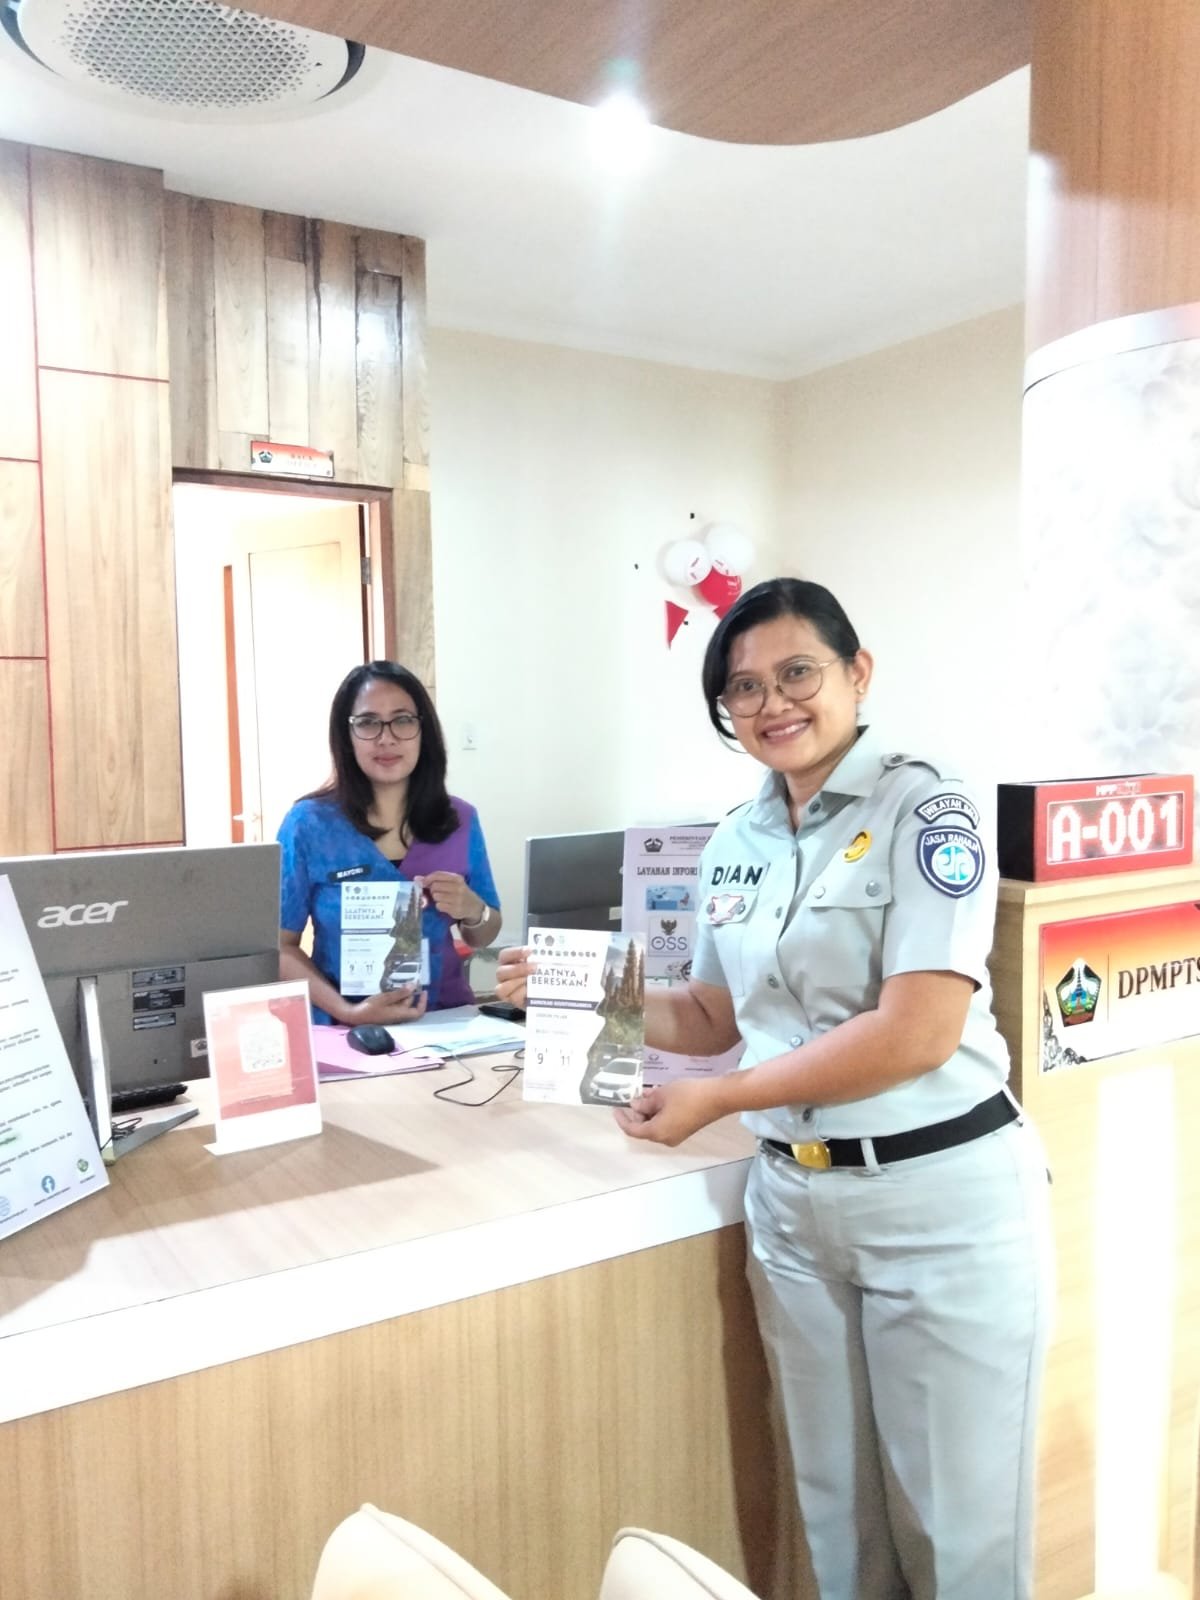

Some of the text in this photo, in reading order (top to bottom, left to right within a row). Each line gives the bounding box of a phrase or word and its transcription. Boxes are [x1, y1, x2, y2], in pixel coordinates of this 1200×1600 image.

[922, 799, 962, 818] WILAYAH
[1052, 796, 1178, 862] A-001
[925, 833, 946, 846] JASA
[711, 864, 763, 886] DIAN
[37, 900, 129, 929] acer
[651, 936, 688, 951] OSS
[532, 968, 576, 978] AATNYA
[537, 1052, 543, 1065] 9
